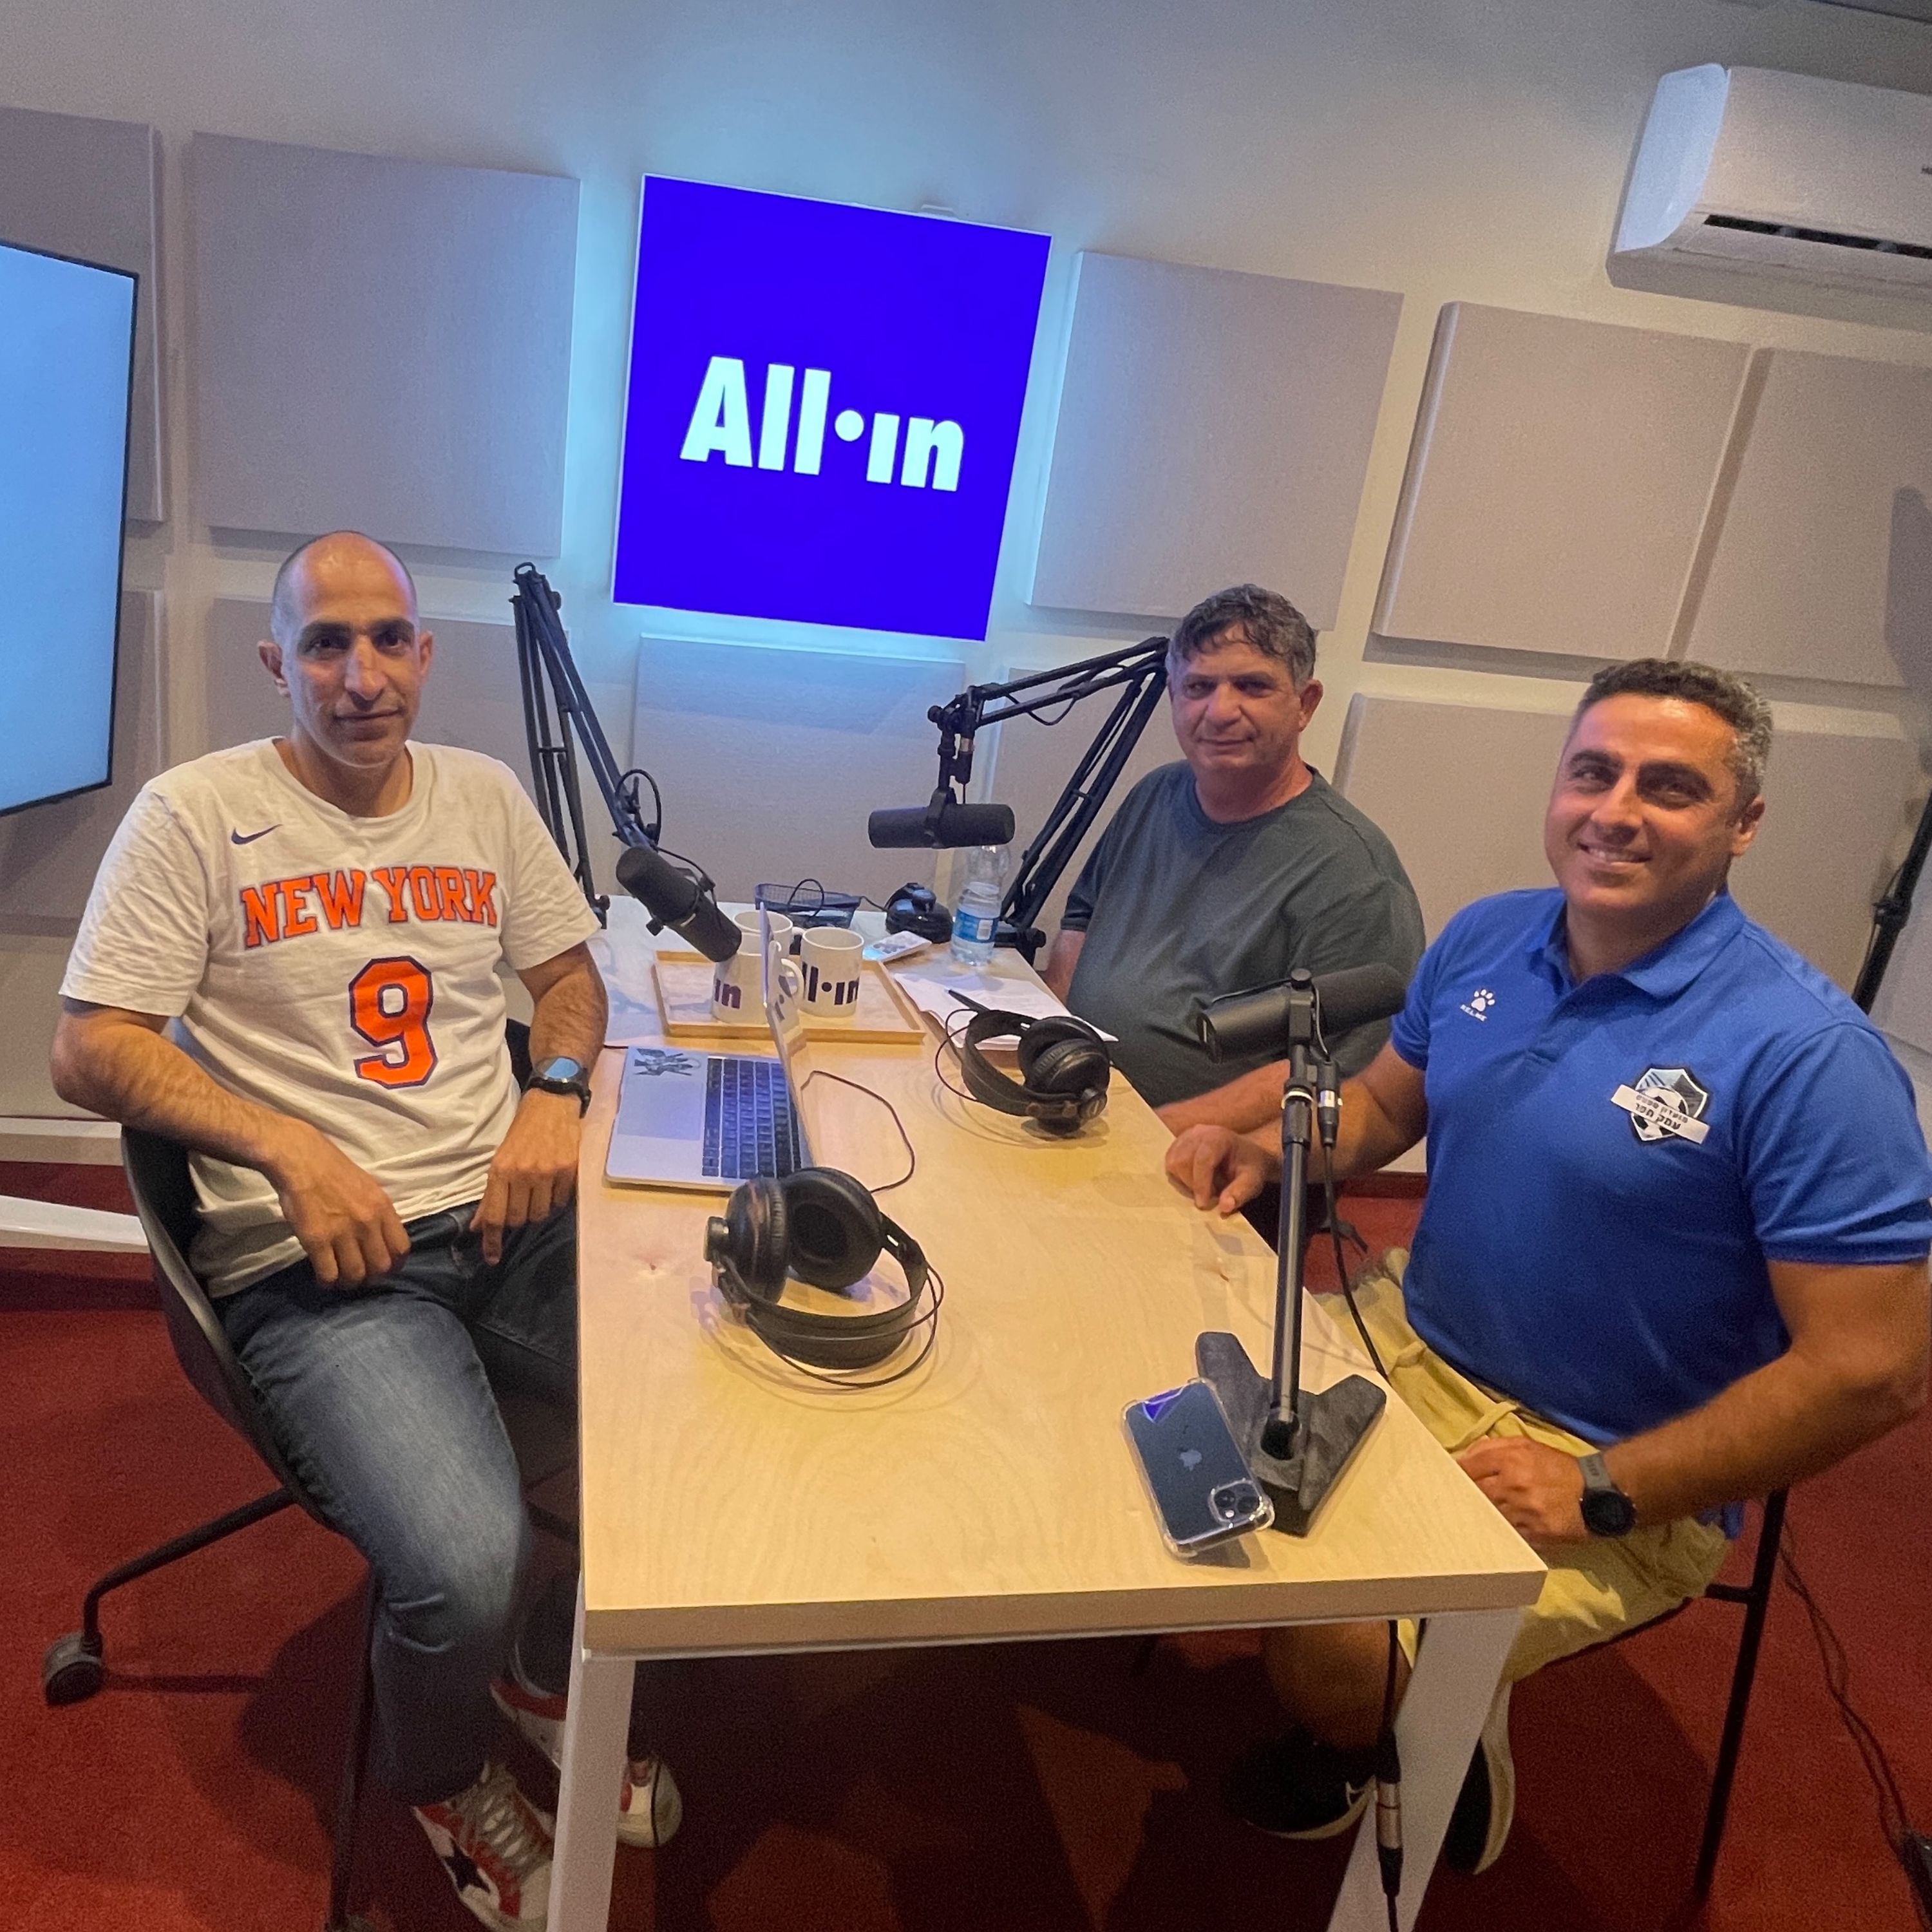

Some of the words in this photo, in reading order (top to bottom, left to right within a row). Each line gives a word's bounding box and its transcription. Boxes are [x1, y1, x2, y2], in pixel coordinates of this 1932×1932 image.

[241, 869, 366, 948] NEW
[373, 866, 498, 927] YORK
[348, 956, 437, 1089] 9
